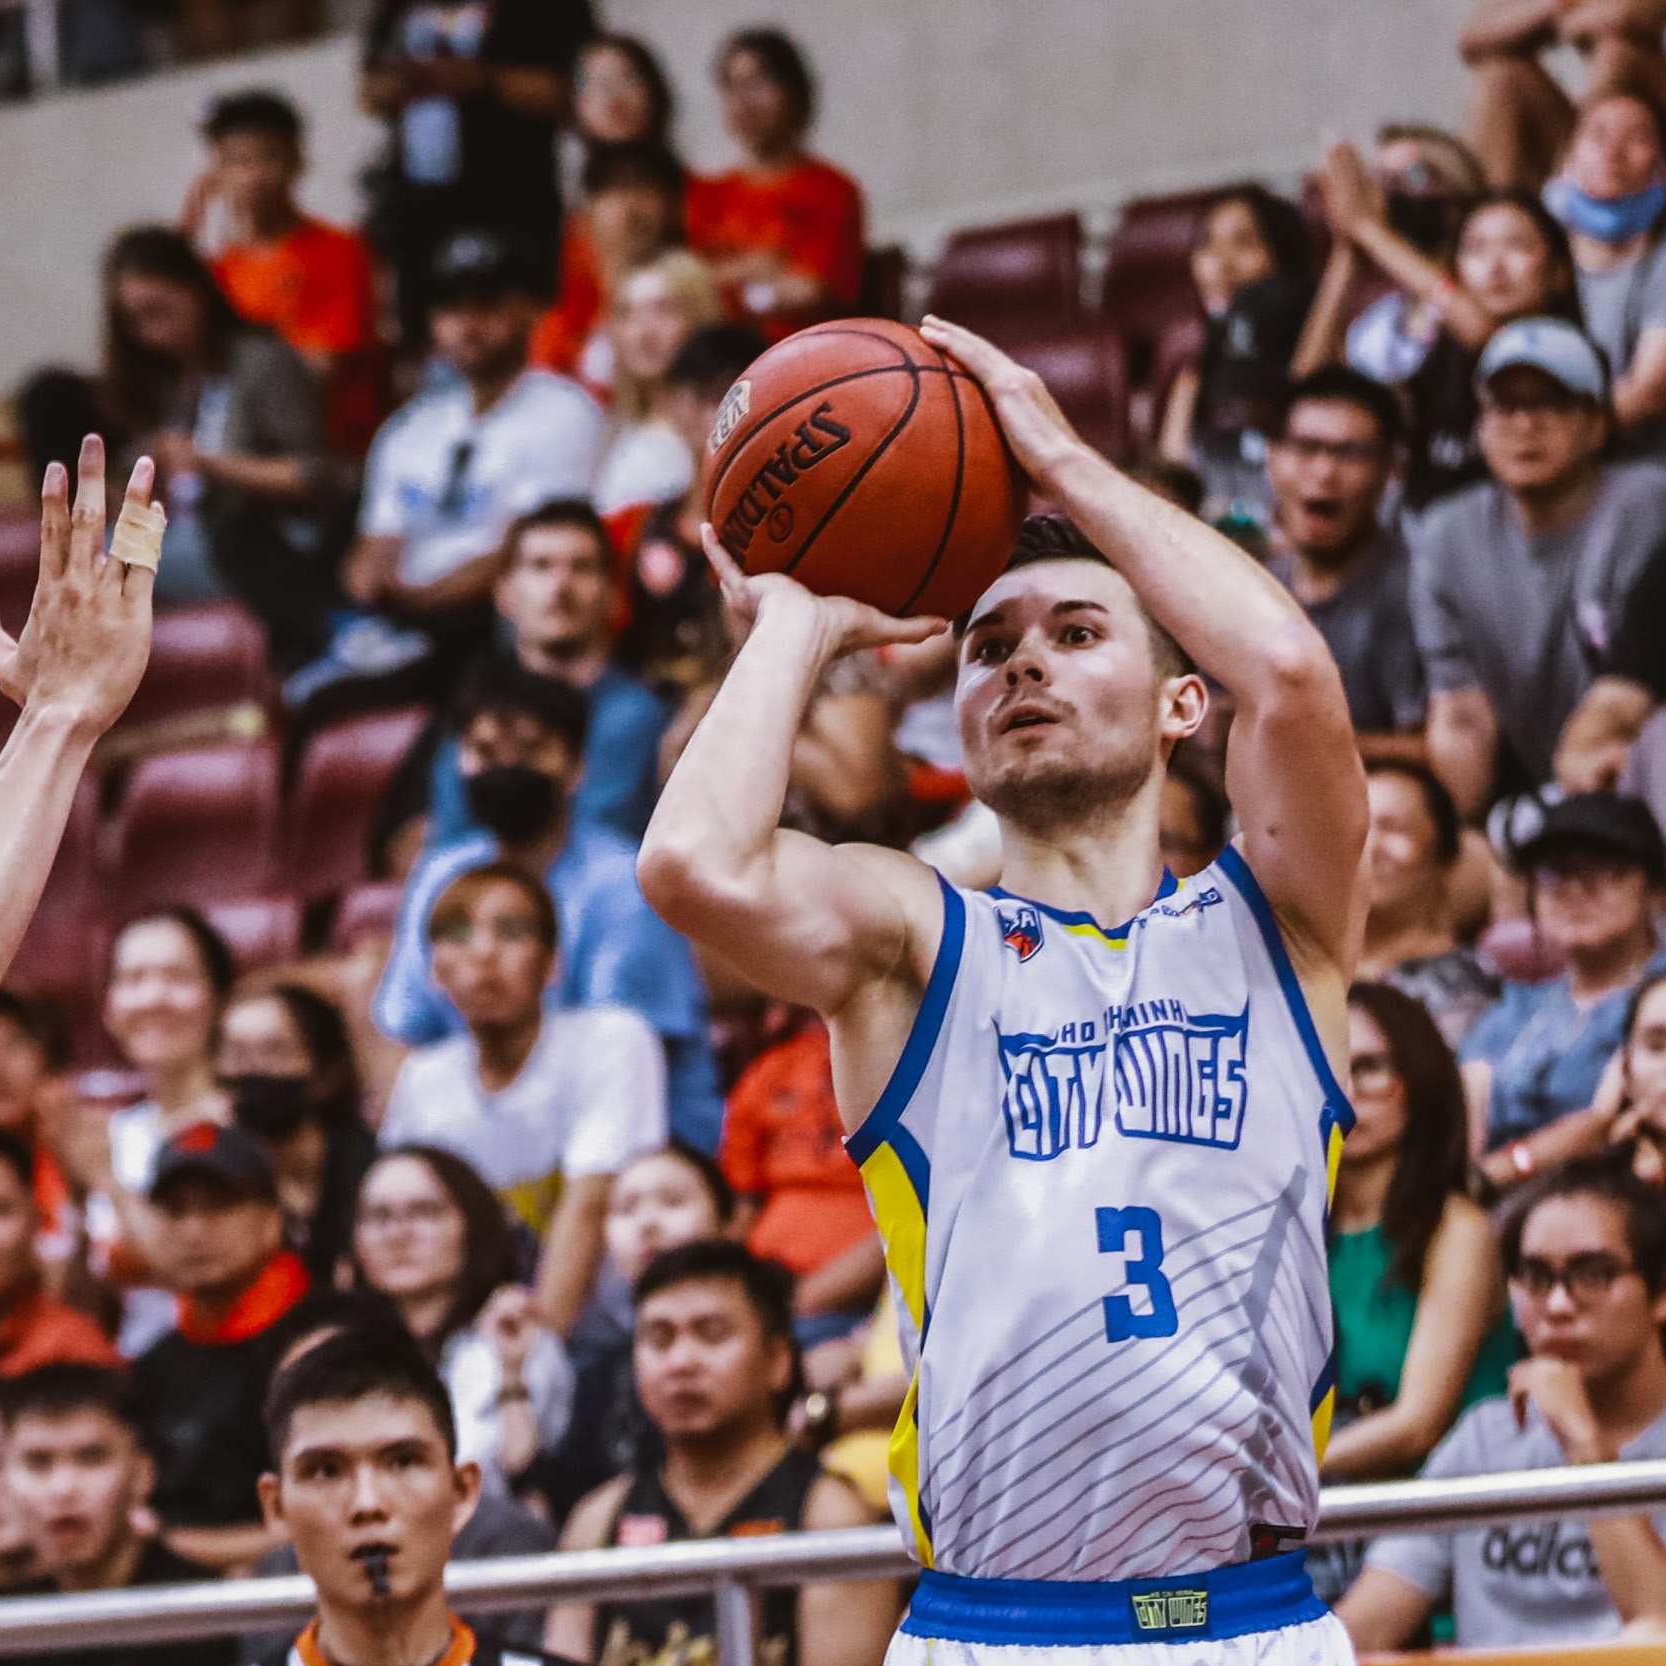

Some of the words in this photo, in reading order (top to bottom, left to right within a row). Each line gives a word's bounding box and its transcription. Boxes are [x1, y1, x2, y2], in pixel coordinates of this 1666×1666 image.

[721, 402, 851, 568] SPALDIN
[1001, 1048, 1105, 1161] CITY
[1114, 1028, 1249, 1151] WINGS
[1095, 1206, 1179, 1343] 3
